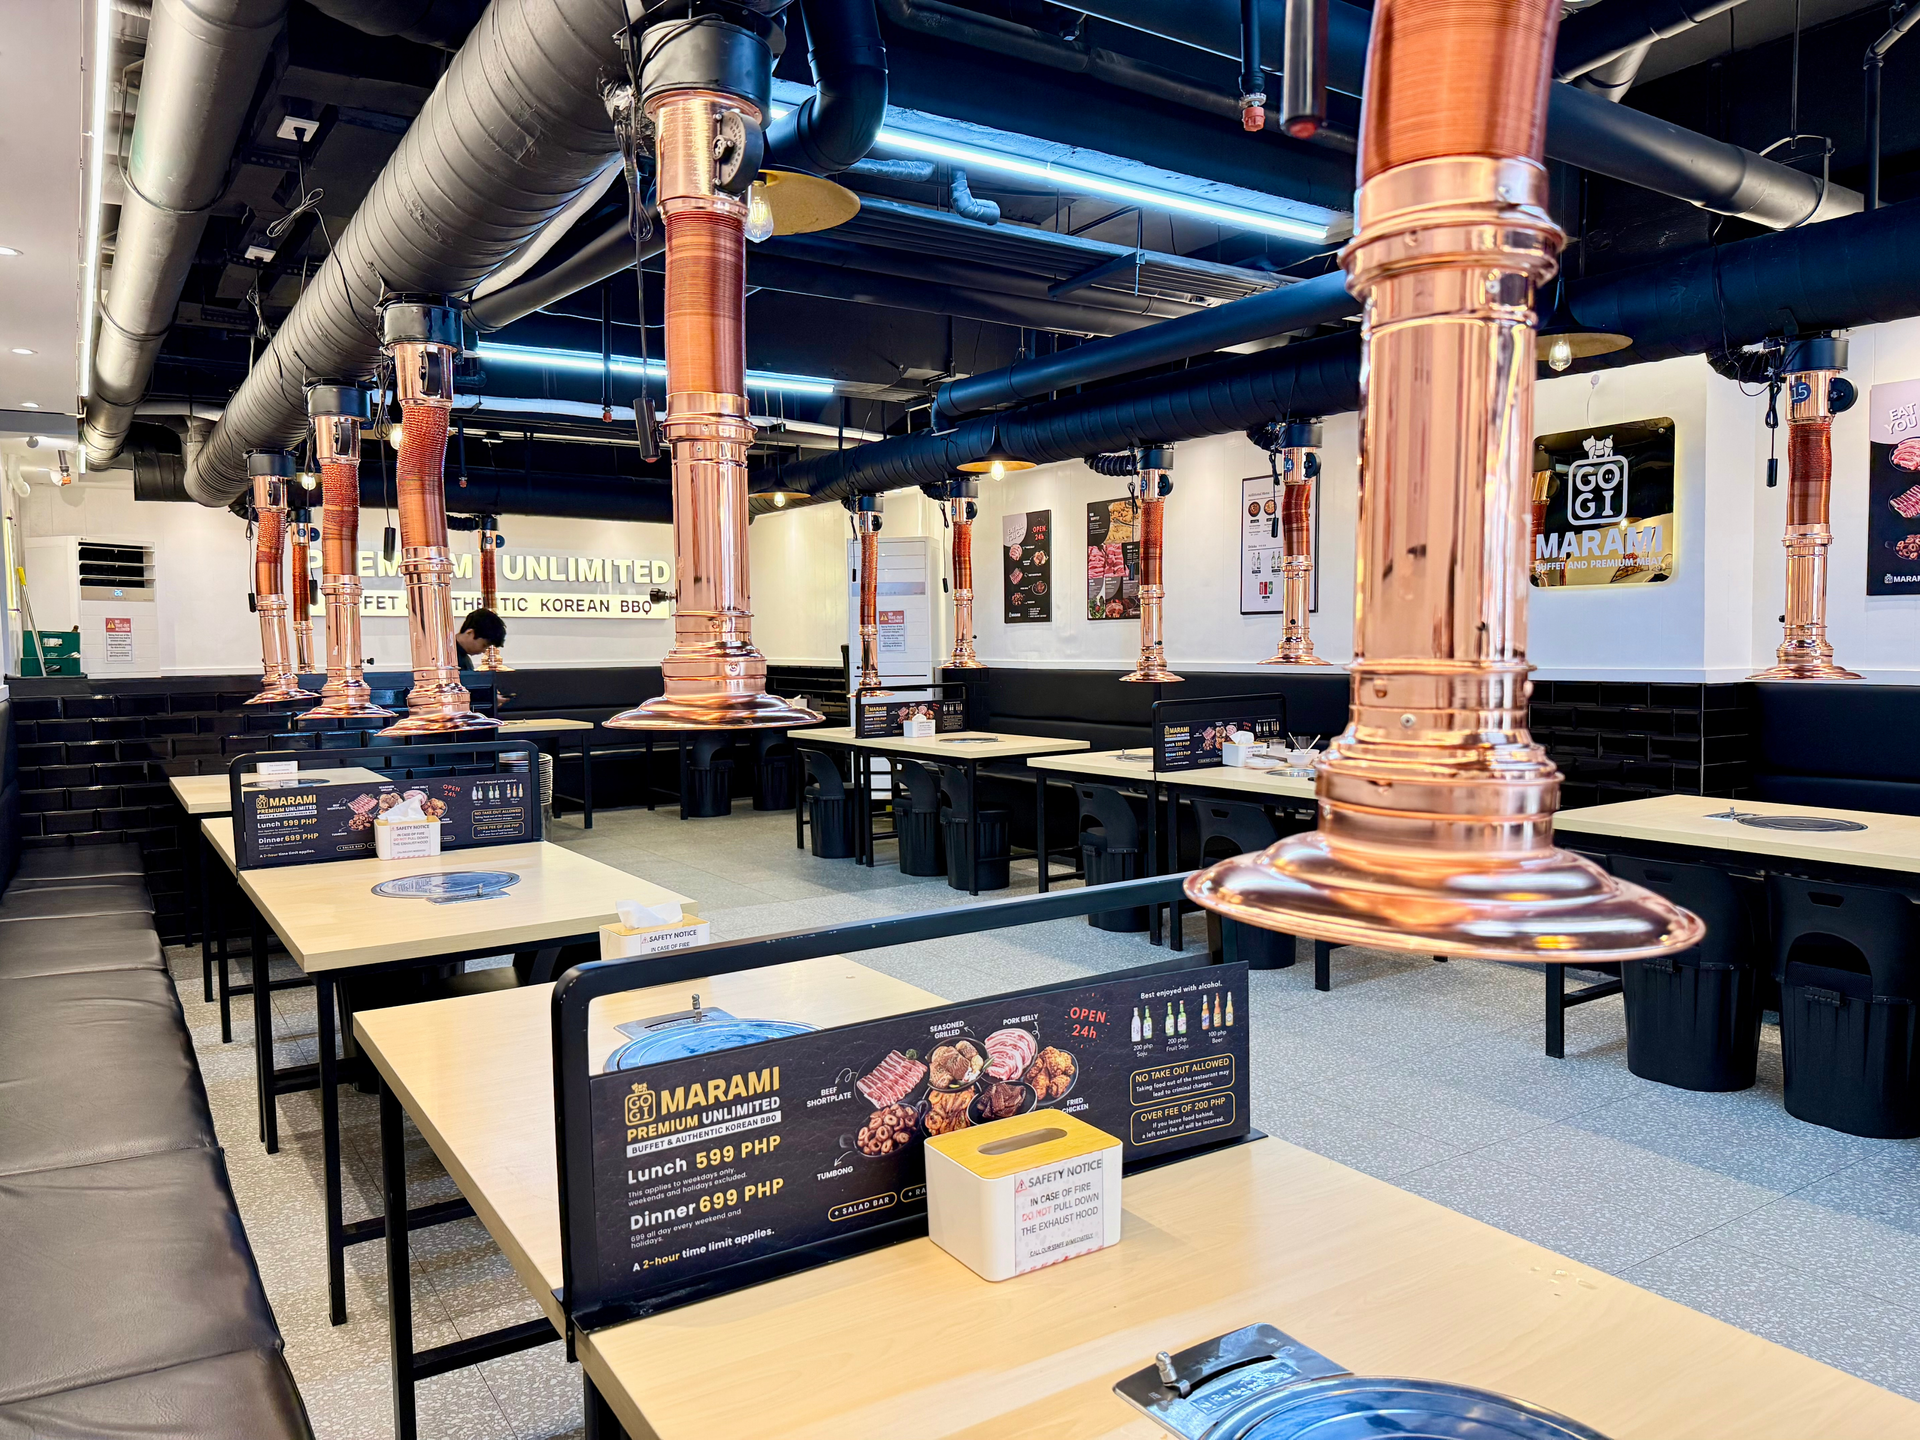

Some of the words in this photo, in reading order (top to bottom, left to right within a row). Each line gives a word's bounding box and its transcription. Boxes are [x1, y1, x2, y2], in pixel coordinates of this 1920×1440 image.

[1791, 385, 1808, 401] 15
[1889, 402, 1916, 421] EAT
[1884, 416, 1918, 435] YOU
[1536, 525, 1663, 559] MARAMI
[310, 551, 472, 578] PEMM
[502, 554, 670, 584] UNLIMITED
[1535, 561, 1566, 571] BUFFET
[1568, 560, 1588, 569] AND
[1591, 558, 1634, 568] PREMIUM
[1636, 557, 1663, 566] MEAT
[540, 598, 610, 613] KOREAN
[620, 600, 652, 615] BBQ
[269, 795, 316, 807] MARAMI
[649, 933, 673, 942] SAFETY
[674, 930, 697, 938] NOTICE
[1157, 987, 1182, 997] enjoyed
[1198, 980, 1222, 990] alcohol.
[1002, 1016, 1020, 1025] PORK
[1021, 1013, 1039, 1023] BELLY
[1069, 1007, 1106, 1023] OPEN
[930, 1020, 965, 1033] SEASONED
[934, 1029, 960, 1039] GRILLED
[1072, 1024, 1097, 1038] 24h
[1136, 1073, 1149, 1083] NO
[1151, 1069, 1171, 1079] TAKE
[1173, 1066, 1190, 1075] OUT
[1192, 1058, 1230, 1072] ALLOWED
[661, 1066, 780, 1116] MARAMI
[820, 1086, 837, 1096] BEEF
[1136, 1084, 1153, 1092] Taking
[1154, 1081, 1166, 1089] food
[1193, 1071, 1218, 1081] restaurant
[1172, 1084, 1192, 1093] criminal
[1193, 1081, 1213, 1090] charges.
[806, 1092, 852, 1108] SHORTPLATE
[1062, 1103, 1089, 1113] CHICKEN
[1066, 1097, 1084, 1106] FRIED
[1141, 1111, 1163, 1122] OVER
[1165, 1107, 1179, 1117] FEE
[1181, 1104, 1193, 1113] OF
[1194, 1101, 1208, 1110] 200
[1210, 1097, 1226, 1107] PHP
[627, 1114, 699, 1142] PREMIUM
[702, 1096, 780, 1125] UNLIMITED
[1186, 1121, 1195, 1129] will
[1203, 1116, 1225, 1125] incurred.
[632, 1140, 664, 1154] BUFFET
[675, 1126, 724, 1144] AUTHENTIC
[725, 1119, 758, 1133] KOREAN
[760, 1114, 777, 1125] BBQ
[628, 1158, 687, 1185] Lunch
[696, 1145, 735, 1169] 599
[741, 1135, 781, 1159] PHP
[816, 1165, 854, 1181] TUMBONG
[1028, 1169, 1065, 1188] SAFETY
[1066, 1159, 1102, 1177] NOTICE
[628, 1189, 643, 1199] This
[645, 1183, 672, 1195] applies
[683, 1170, 718, 1185] weekdays
[719, 1167, 736, 1178] only.
[628, 1193, 665, 1207] weekends
[667, 1188, 681, 1197] and
[683, 1180, 713, 1194] holidays
[714, 1172, 747, 1185] excluded.
[630, 1201, 697, 1230] Dinner
[700, 1189, 738, 1213] 699
[744, 1178, 784, 1202] PHP
[1030, 1198, 1038, 1207] IN
[1040, 1191, 1060, 1204] CASE
[1062, 1187, 1072, 1197] OF
[1074, 1182, 1091, 1194] FIRE
[842, 1202, 870, 1215] SALAD
[873, 1197, 890, 1207] BAR
[1022, 1212, 1034, 1222] DO
[1036, 1206, 1052, 1218] NOT
[1054, 1201, 1073, 1213] PULL
[1075, 1192, 1100, 1206] DOWN
[631, 1233, 645, 1242] 699
[658, 1226, 672, 1237] day
[673, 1222, 693, 1232] every
[695, 1212, 726, 1226] weekend
[728, 1209, 742, 1217] and
[1021, 1225, 1036, 1236] THE
[1038, 1213, 1074, 1231] EXHAUST
[1076, 1206, 1098, 1220] HOOD
[631, 1236, 664, 1249] holidays.
[632, 1262, 641, 1272] A
[643, 1252, 681, 1269] 2-hour
[682, 1245, 706, 1258] time
[708, 1237, 733, 1251] limit
[735, 1228, 775, 1247] applies.
